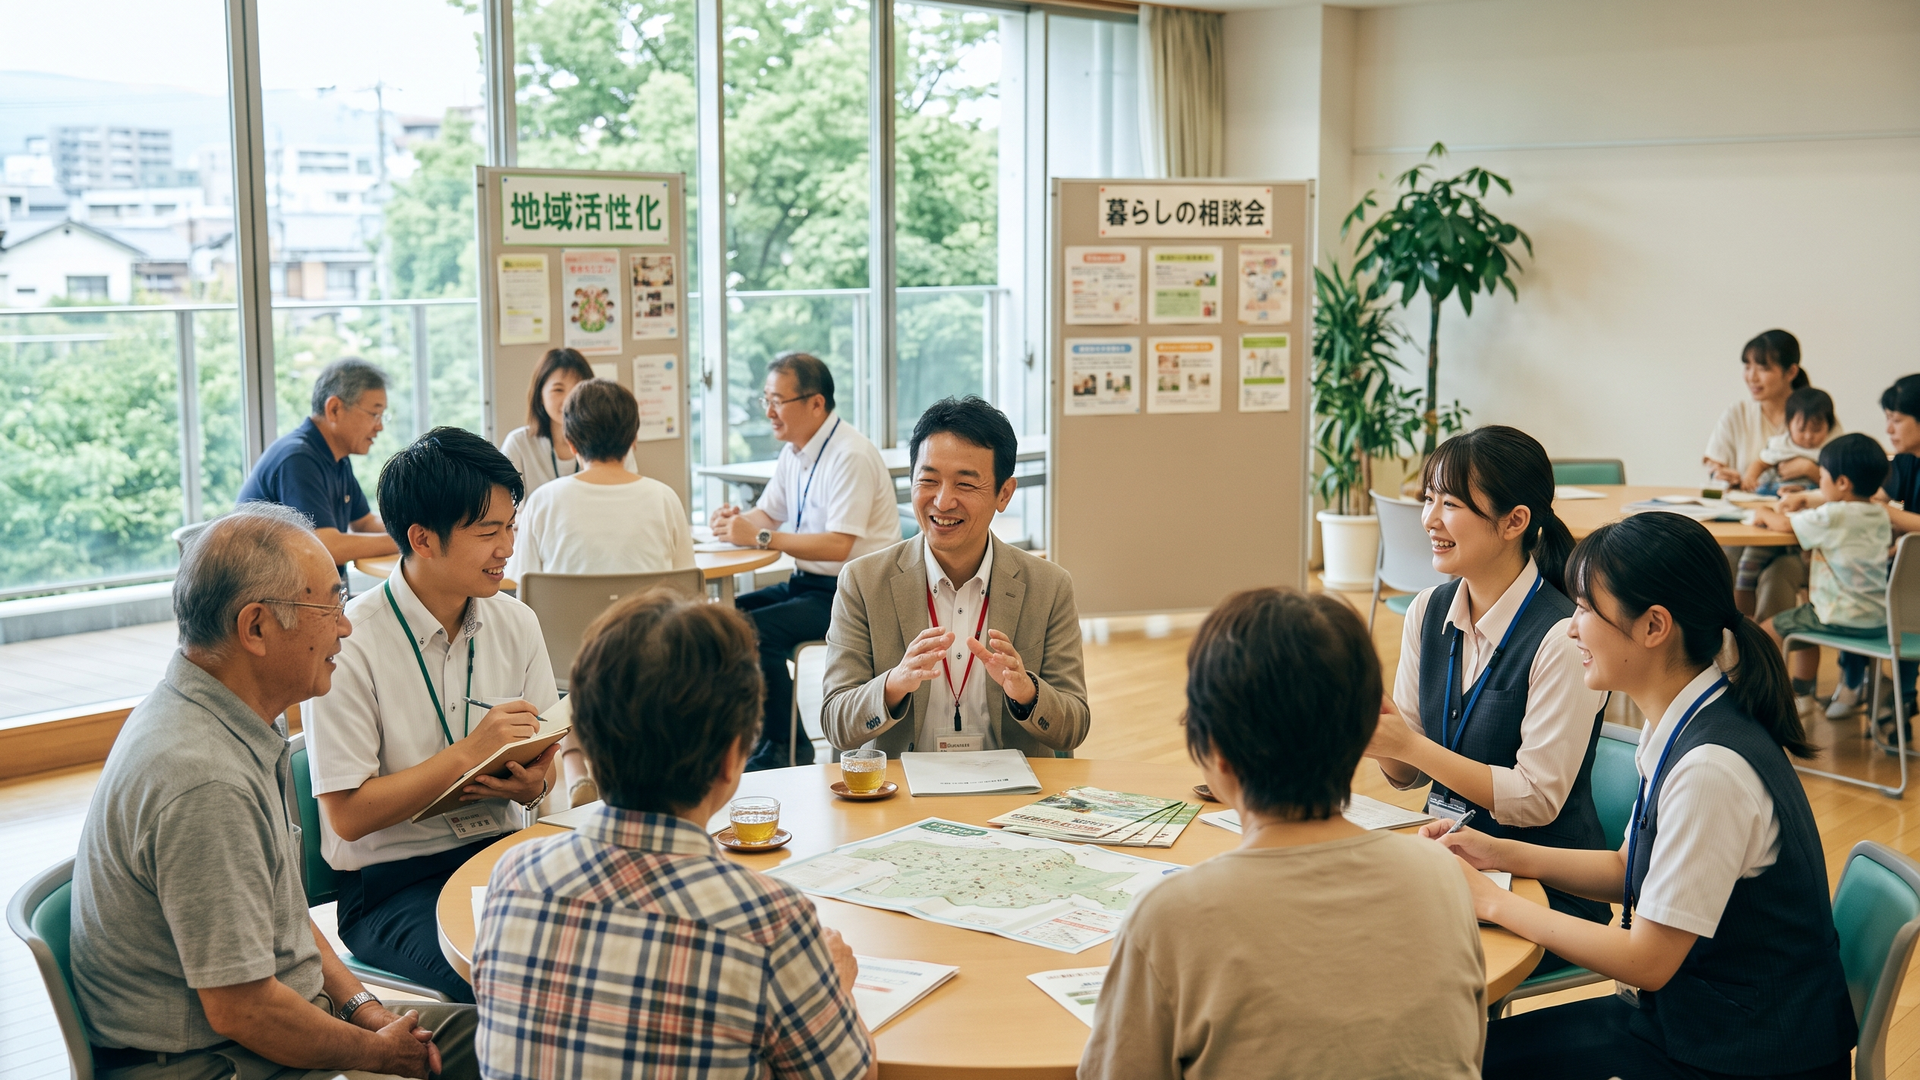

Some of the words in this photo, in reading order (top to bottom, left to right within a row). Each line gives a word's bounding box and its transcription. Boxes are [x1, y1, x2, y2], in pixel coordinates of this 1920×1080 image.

[511, 191, 662, 231] 地域活性化
[1106, 198, 1265, 227] 暮らしの相談会
